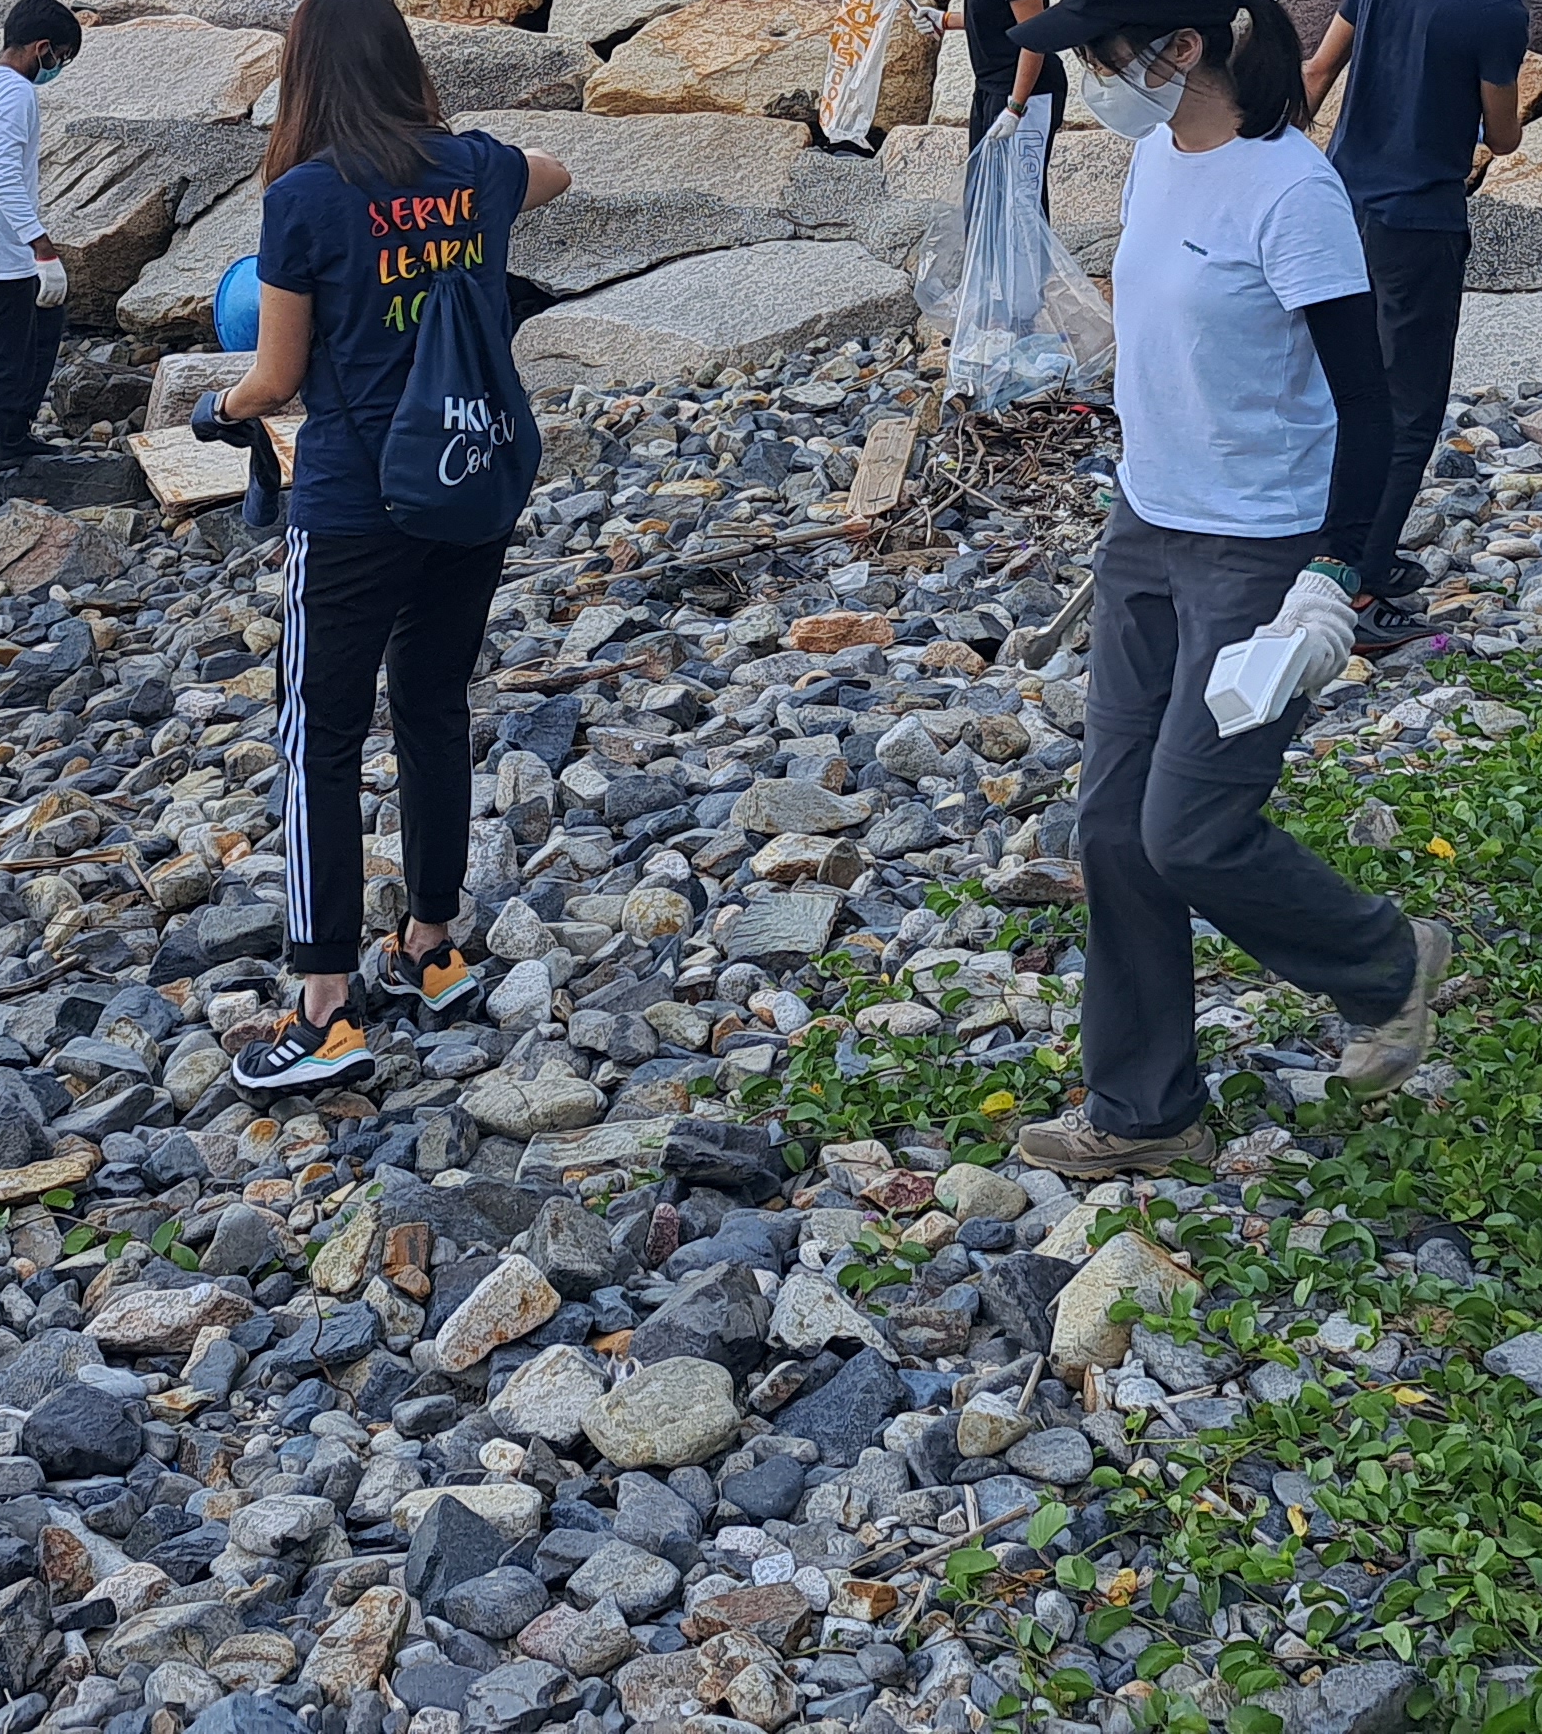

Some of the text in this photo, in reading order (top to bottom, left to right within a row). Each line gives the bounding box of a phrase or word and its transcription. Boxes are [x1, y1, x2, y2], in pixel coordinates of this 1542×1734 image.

[368, 188, 479, 237] SERVE
[378, 232, 483, 285] LEARN
[381, 290, 429, 332] AC
